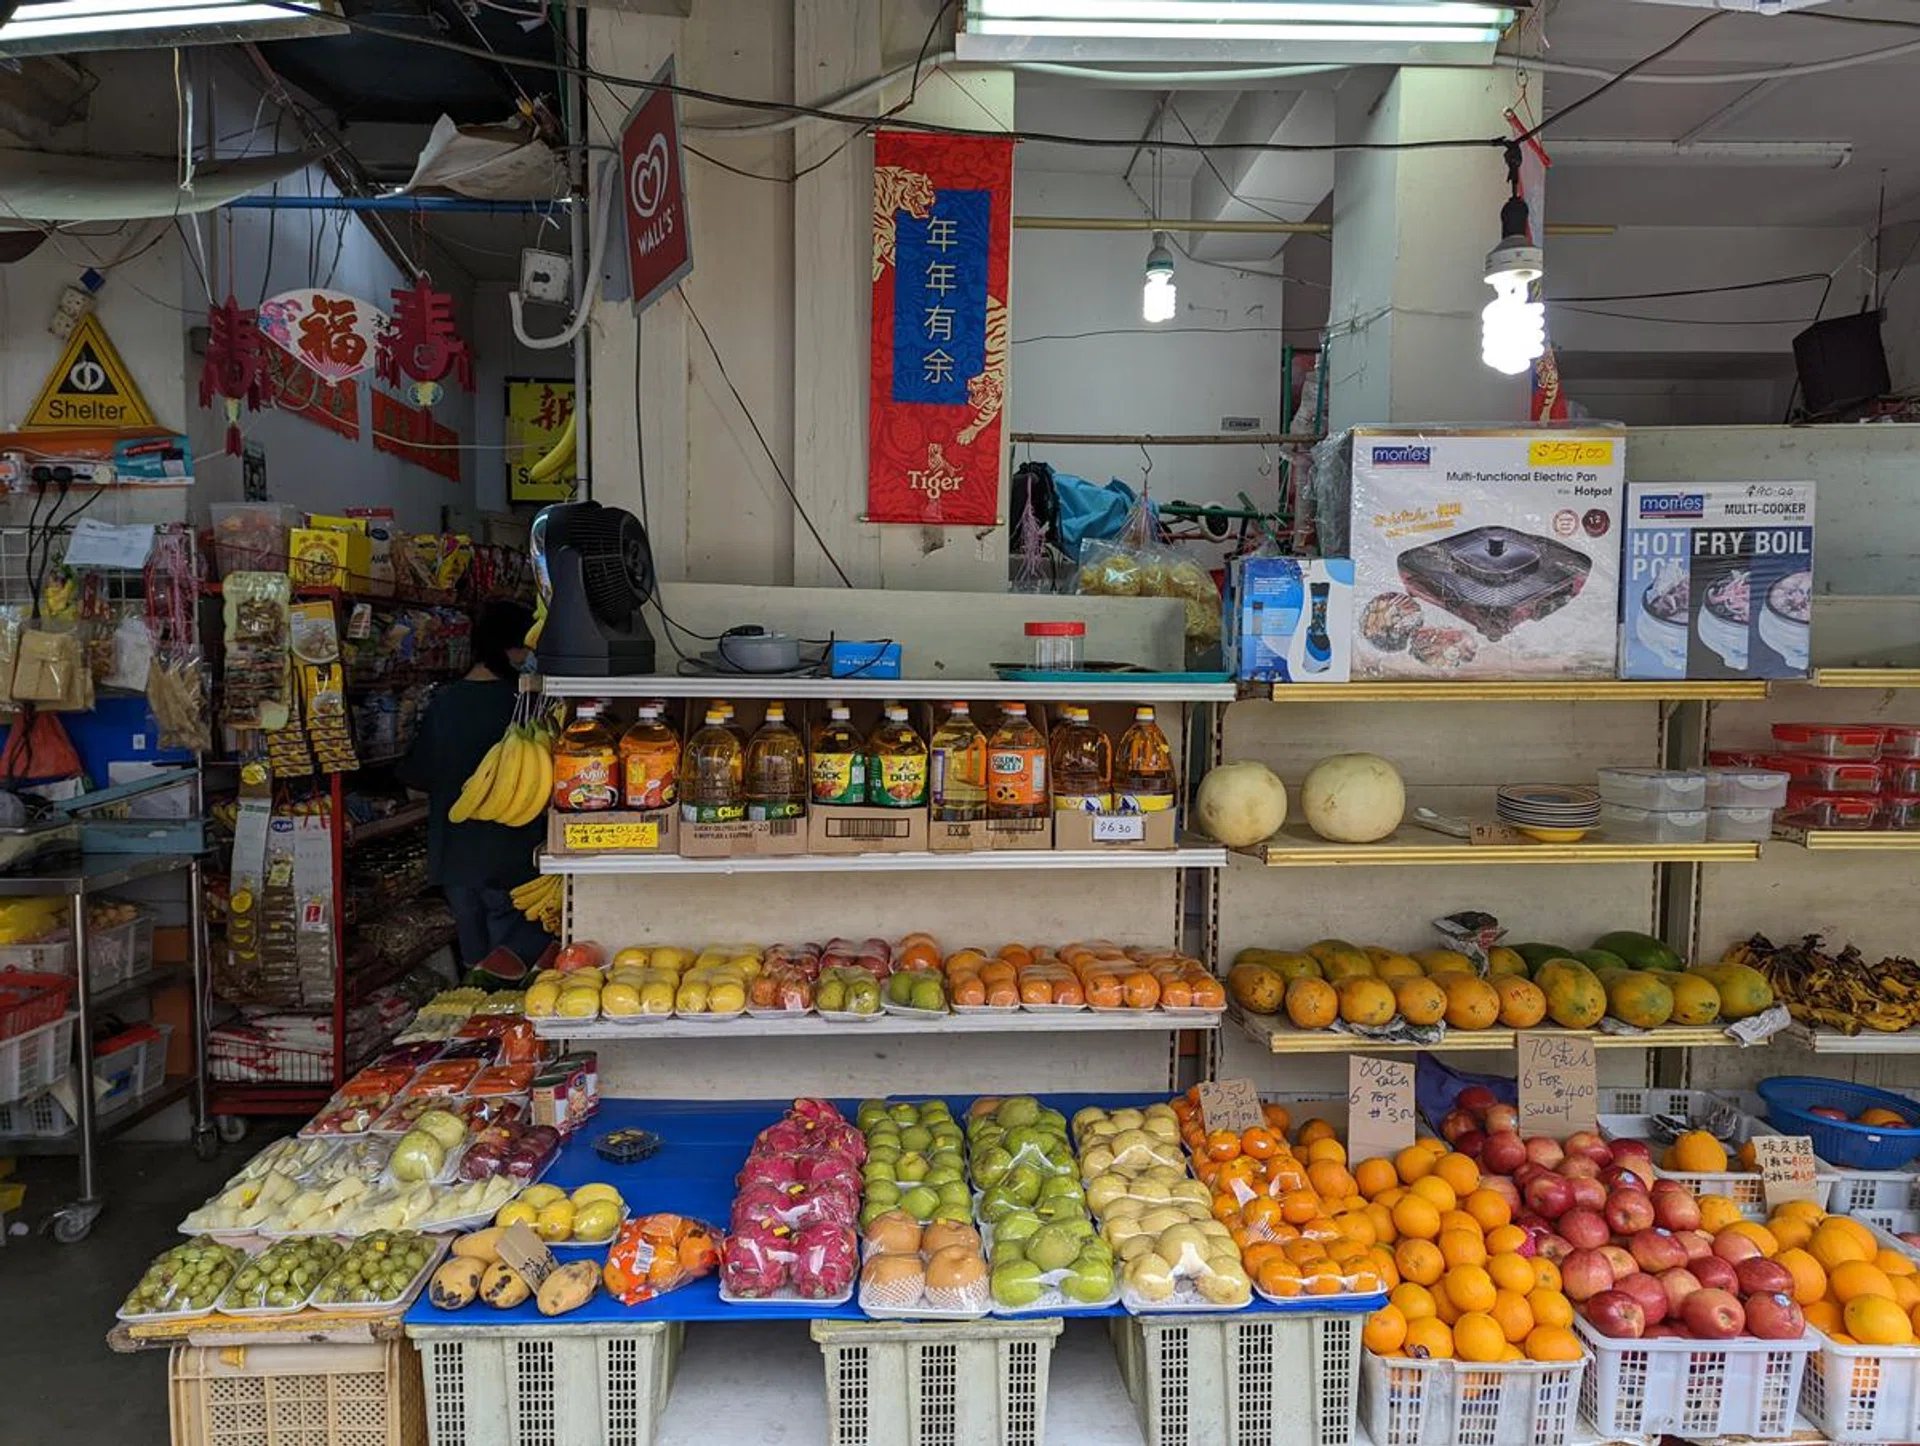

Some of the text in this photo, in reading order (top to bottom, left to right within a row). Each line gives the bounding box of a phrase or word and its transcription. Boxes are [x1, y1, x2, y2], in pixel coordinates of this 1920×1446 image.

[637, 208, 674, 257] WALL'S
[922, 216, 959, 384] 年年有余
[298, 294, 368, 366] 福
[49, 400, 127, 420] Shelter
[1373, 445, 1430, 462] morries
[907, 470, 964, 500] Tiger
[1446, 471, 1598, 482] Multi-functional Electric Pan
[1574, 486, 1613, 498] Hotpot
[1641, 493, 1702, 511] morries
[1724, 503, 1806, 515] MULTI-COOKER
[1633, 532, 1687, 556] HOT
[1694, 531, 1745, 555] FRY
[1755, 530, 1810, 554] BOIL
[812, 771, 842, 780] DUCK
[889, 772, 922, 782] DUCK
[1523, 1068, 1533, 1089] 6
[1349, 1086, 1362, 1105] 6
